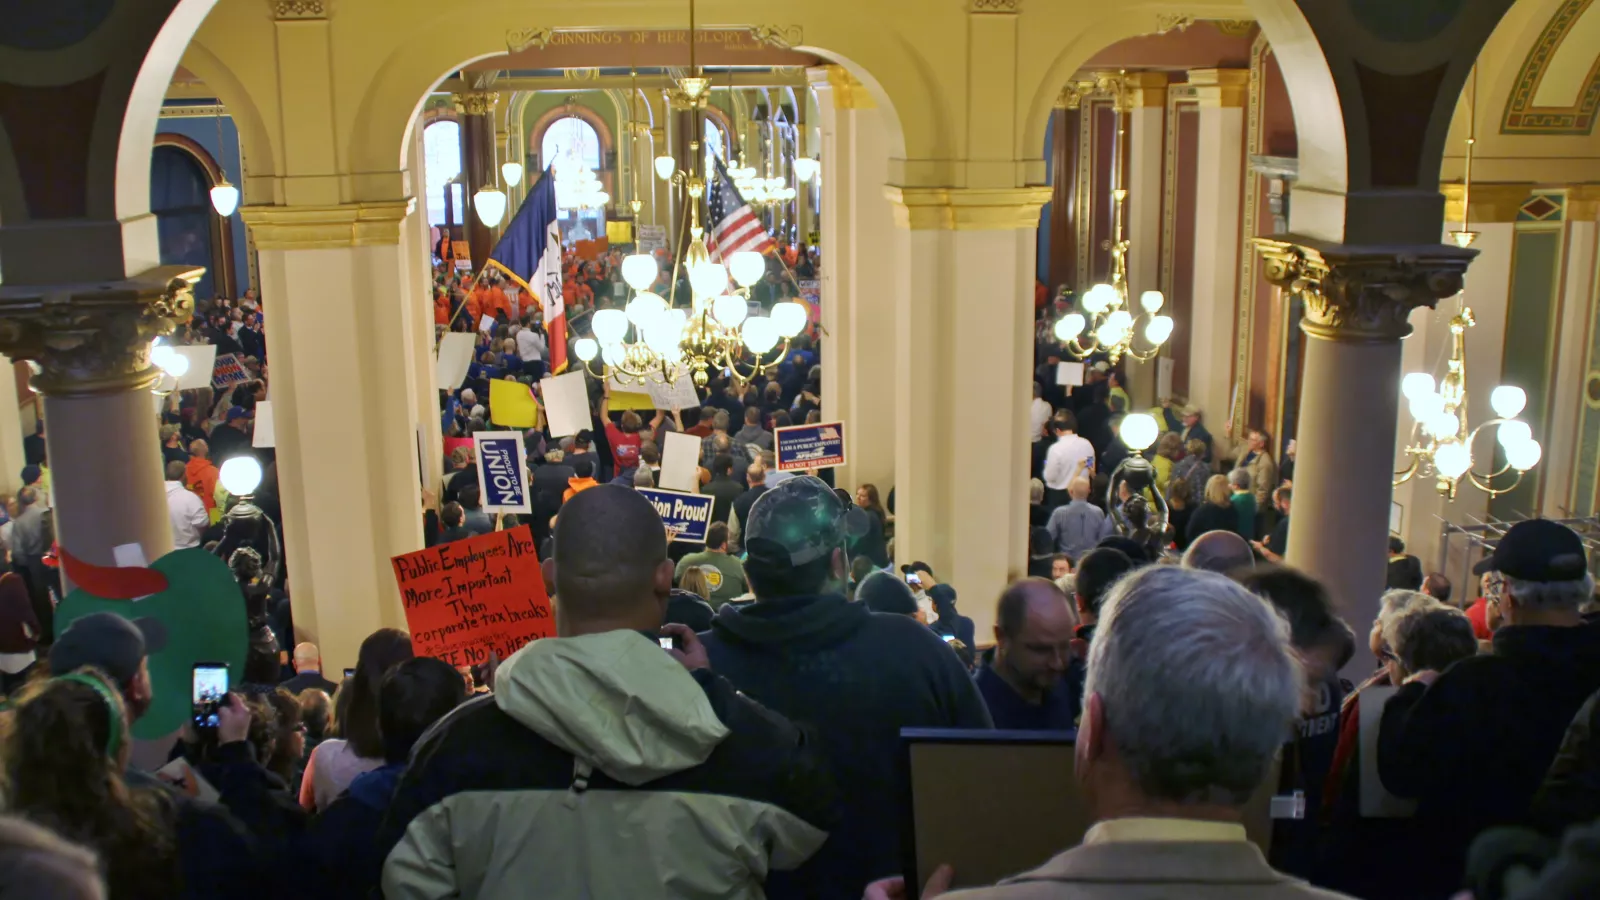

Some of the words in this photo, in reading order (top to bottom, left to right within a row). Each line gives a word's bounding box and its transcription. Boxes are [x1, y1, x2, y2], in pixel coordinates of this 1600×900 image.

[550, 32, 622, 46] GINNINGS
[629, 32, 649, 44] OF
[656, 31, 688, 44] HER
[693, 31, 743, 44] GLORY
[480, 441, 518, 504] UNION
[500, 449, 514, 475] PROUD
[510, 476, 518, 485] TO
[514, 486, 522, 496] BE
[644, 494, 671, 518] ion
[673, 498, 708, 522] Proud
[395, 557, 440, 582] Public
[438, 544, 507, 574] Employees
[507, 532, 534, 557] Are
[404, 585, 444, 608] More
[441, 565, 512, 599] Important
[445, 599, 487, 616] Than
[414, 616, 480, 644] corporate
[480, 612, 506, 626] tax
[503, 599, 549, 624] breaks
[440, 649, 462, 667] TE
[463, 645, 486, 663] No
